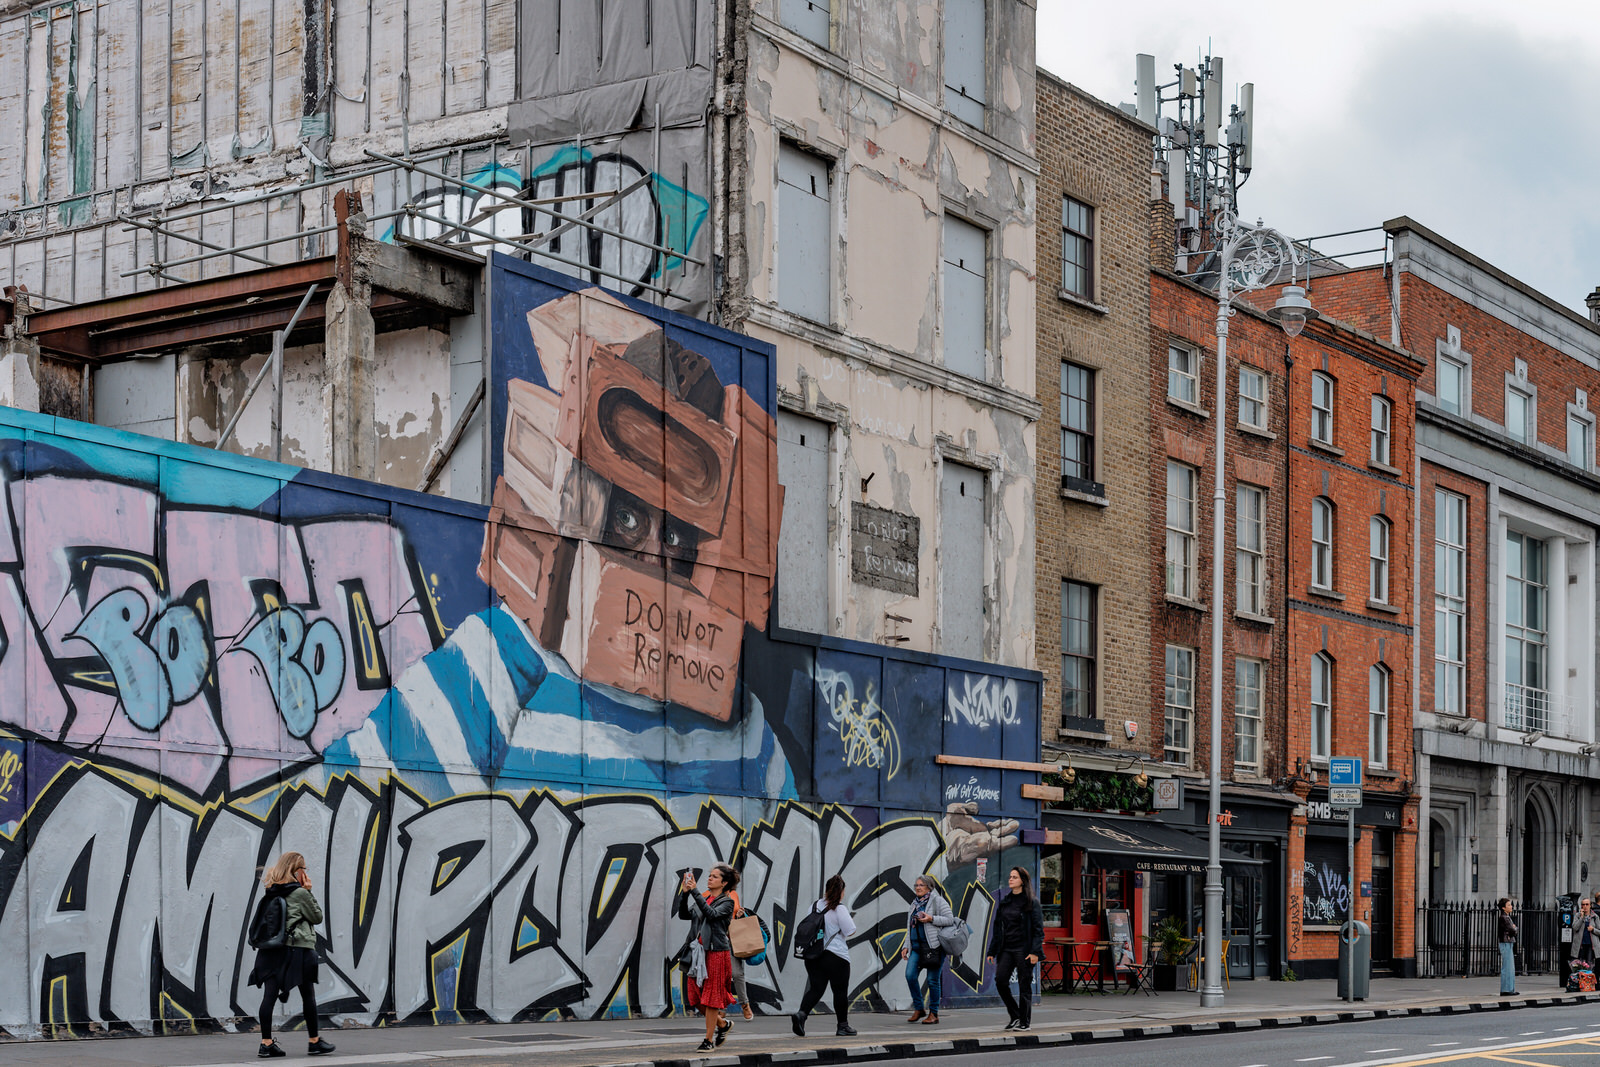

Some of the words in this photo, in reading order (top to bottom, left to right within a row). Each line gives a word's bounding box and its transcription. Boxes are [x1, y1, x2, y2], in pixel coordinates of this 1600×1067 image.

[625, 588, 664, 633] DO
[633, 632, 725, 692] Remove
[1136, 862, 1151, 870] CAFE
[1153, 863, 1188, 872] RESTAURANT
